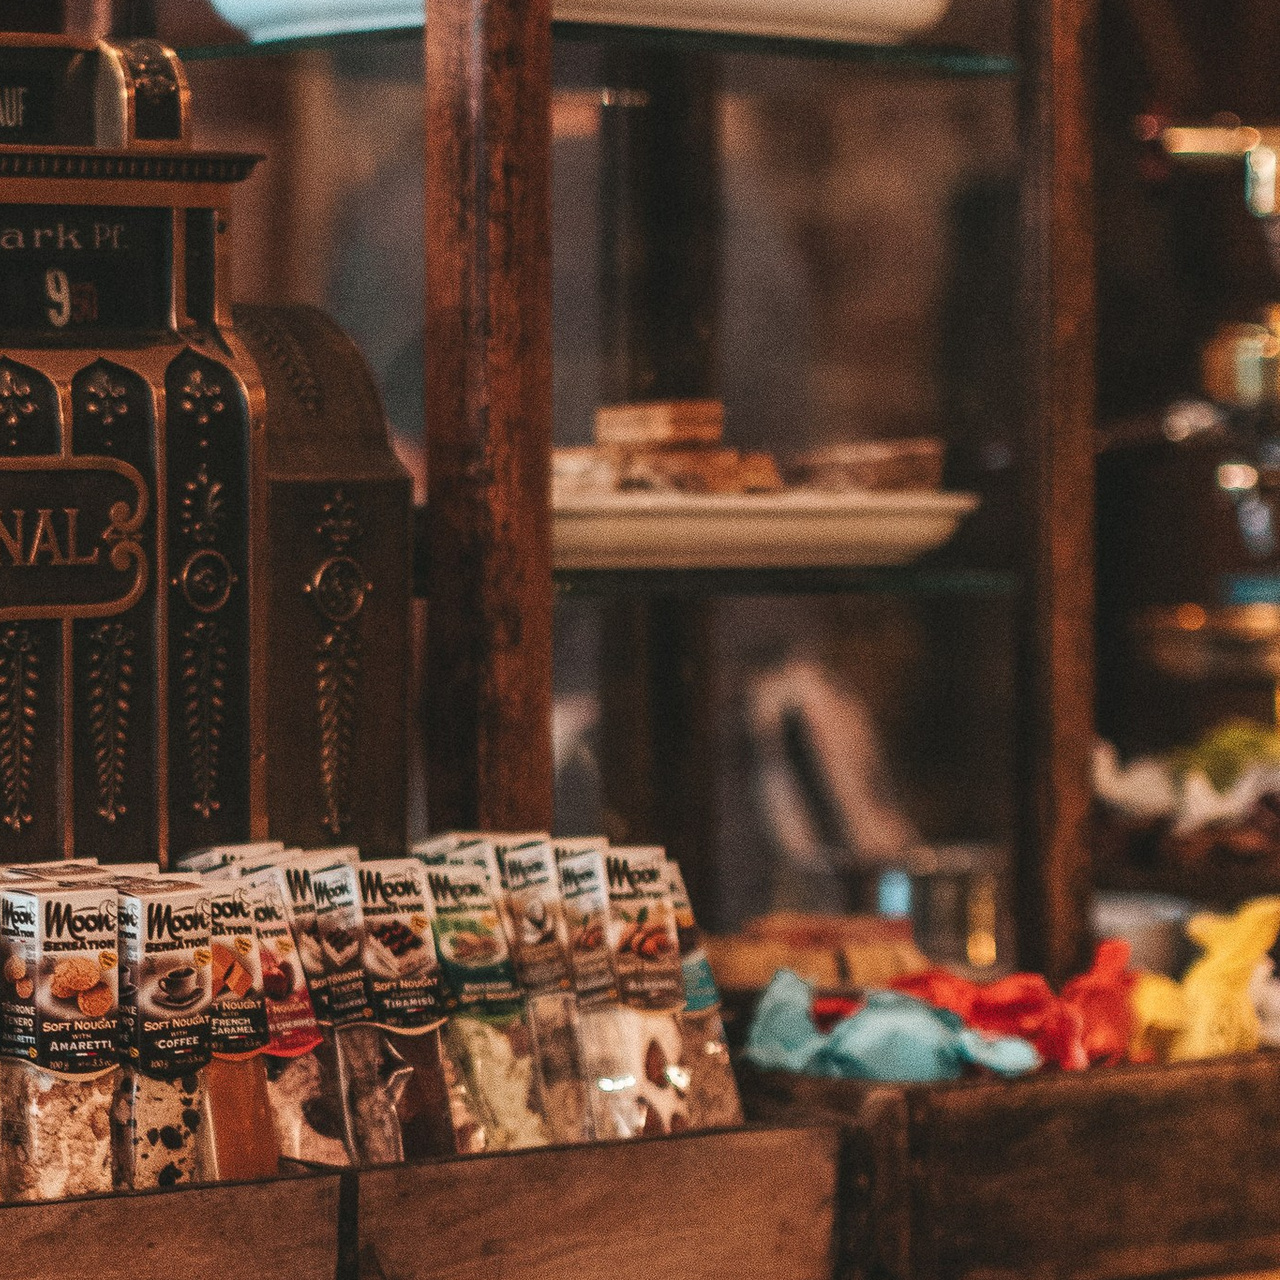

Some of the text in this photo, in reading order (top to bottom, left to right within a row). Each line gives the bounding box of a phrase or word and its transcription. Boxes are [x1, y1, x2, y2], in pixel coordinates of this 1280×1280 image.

[44, 268, 71, 328] 9
[359, 869, 420, 907] Moon
[1, 898, 35, 929] Moon
[44, 900, 116, 940] Moon
[211, 901, 251, 923] oon
[147, 902, 210, 940] Moon
[42, 939, 116, 952] SENSATION
[145, 937, 210, 953] SENSATION
[400, 977, 438, 988] NOUGAT
[222, 1000, 261, 1010] NOUGAT
[42, 1018, 117, 1032] SOFT NOUGAT
[144, 1015, 210, 1032] SOFT NOUGAT
[212, 1018, 250, 1026] FRENCH
[50, 1040, 112, 1052] AMARETTI
[157, 1036, 199, 1049] COFFEE
